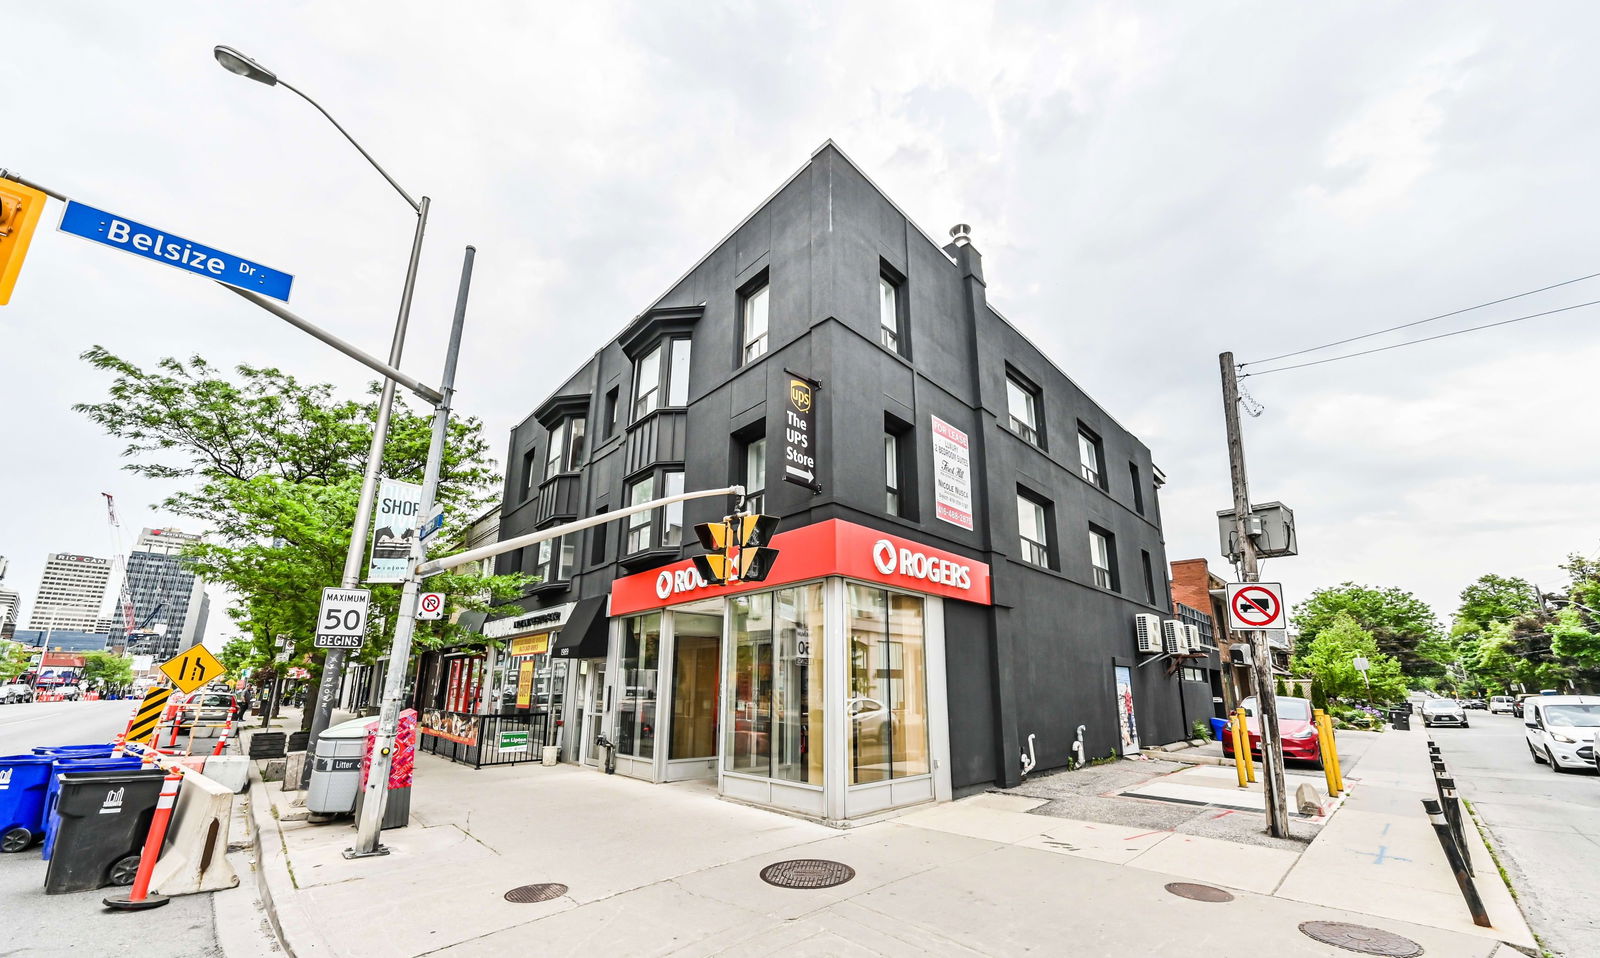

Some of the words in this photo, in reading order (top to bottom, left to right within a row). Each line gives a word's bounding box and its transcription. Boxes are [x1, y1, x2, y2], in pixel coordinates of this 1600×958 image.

[107, 219, 225, 275] Belsize
[239, 263, 256, 276] Dr
[792, 387, 809, 406] ups
[787, 410, 806, 431] The
[934, 421, 948, 434] FOR
[786, 428, 808, 448] UPS
[786, 446, 814, 468] Store
[899, 547, 971, 590] ROGERS
[327, 593, 366, 602] MAXIMUM
[324, 608, 360, 630] 50
[320, 635, 359, 646] BEGINS
[335, 760, 352, 769] Litter
